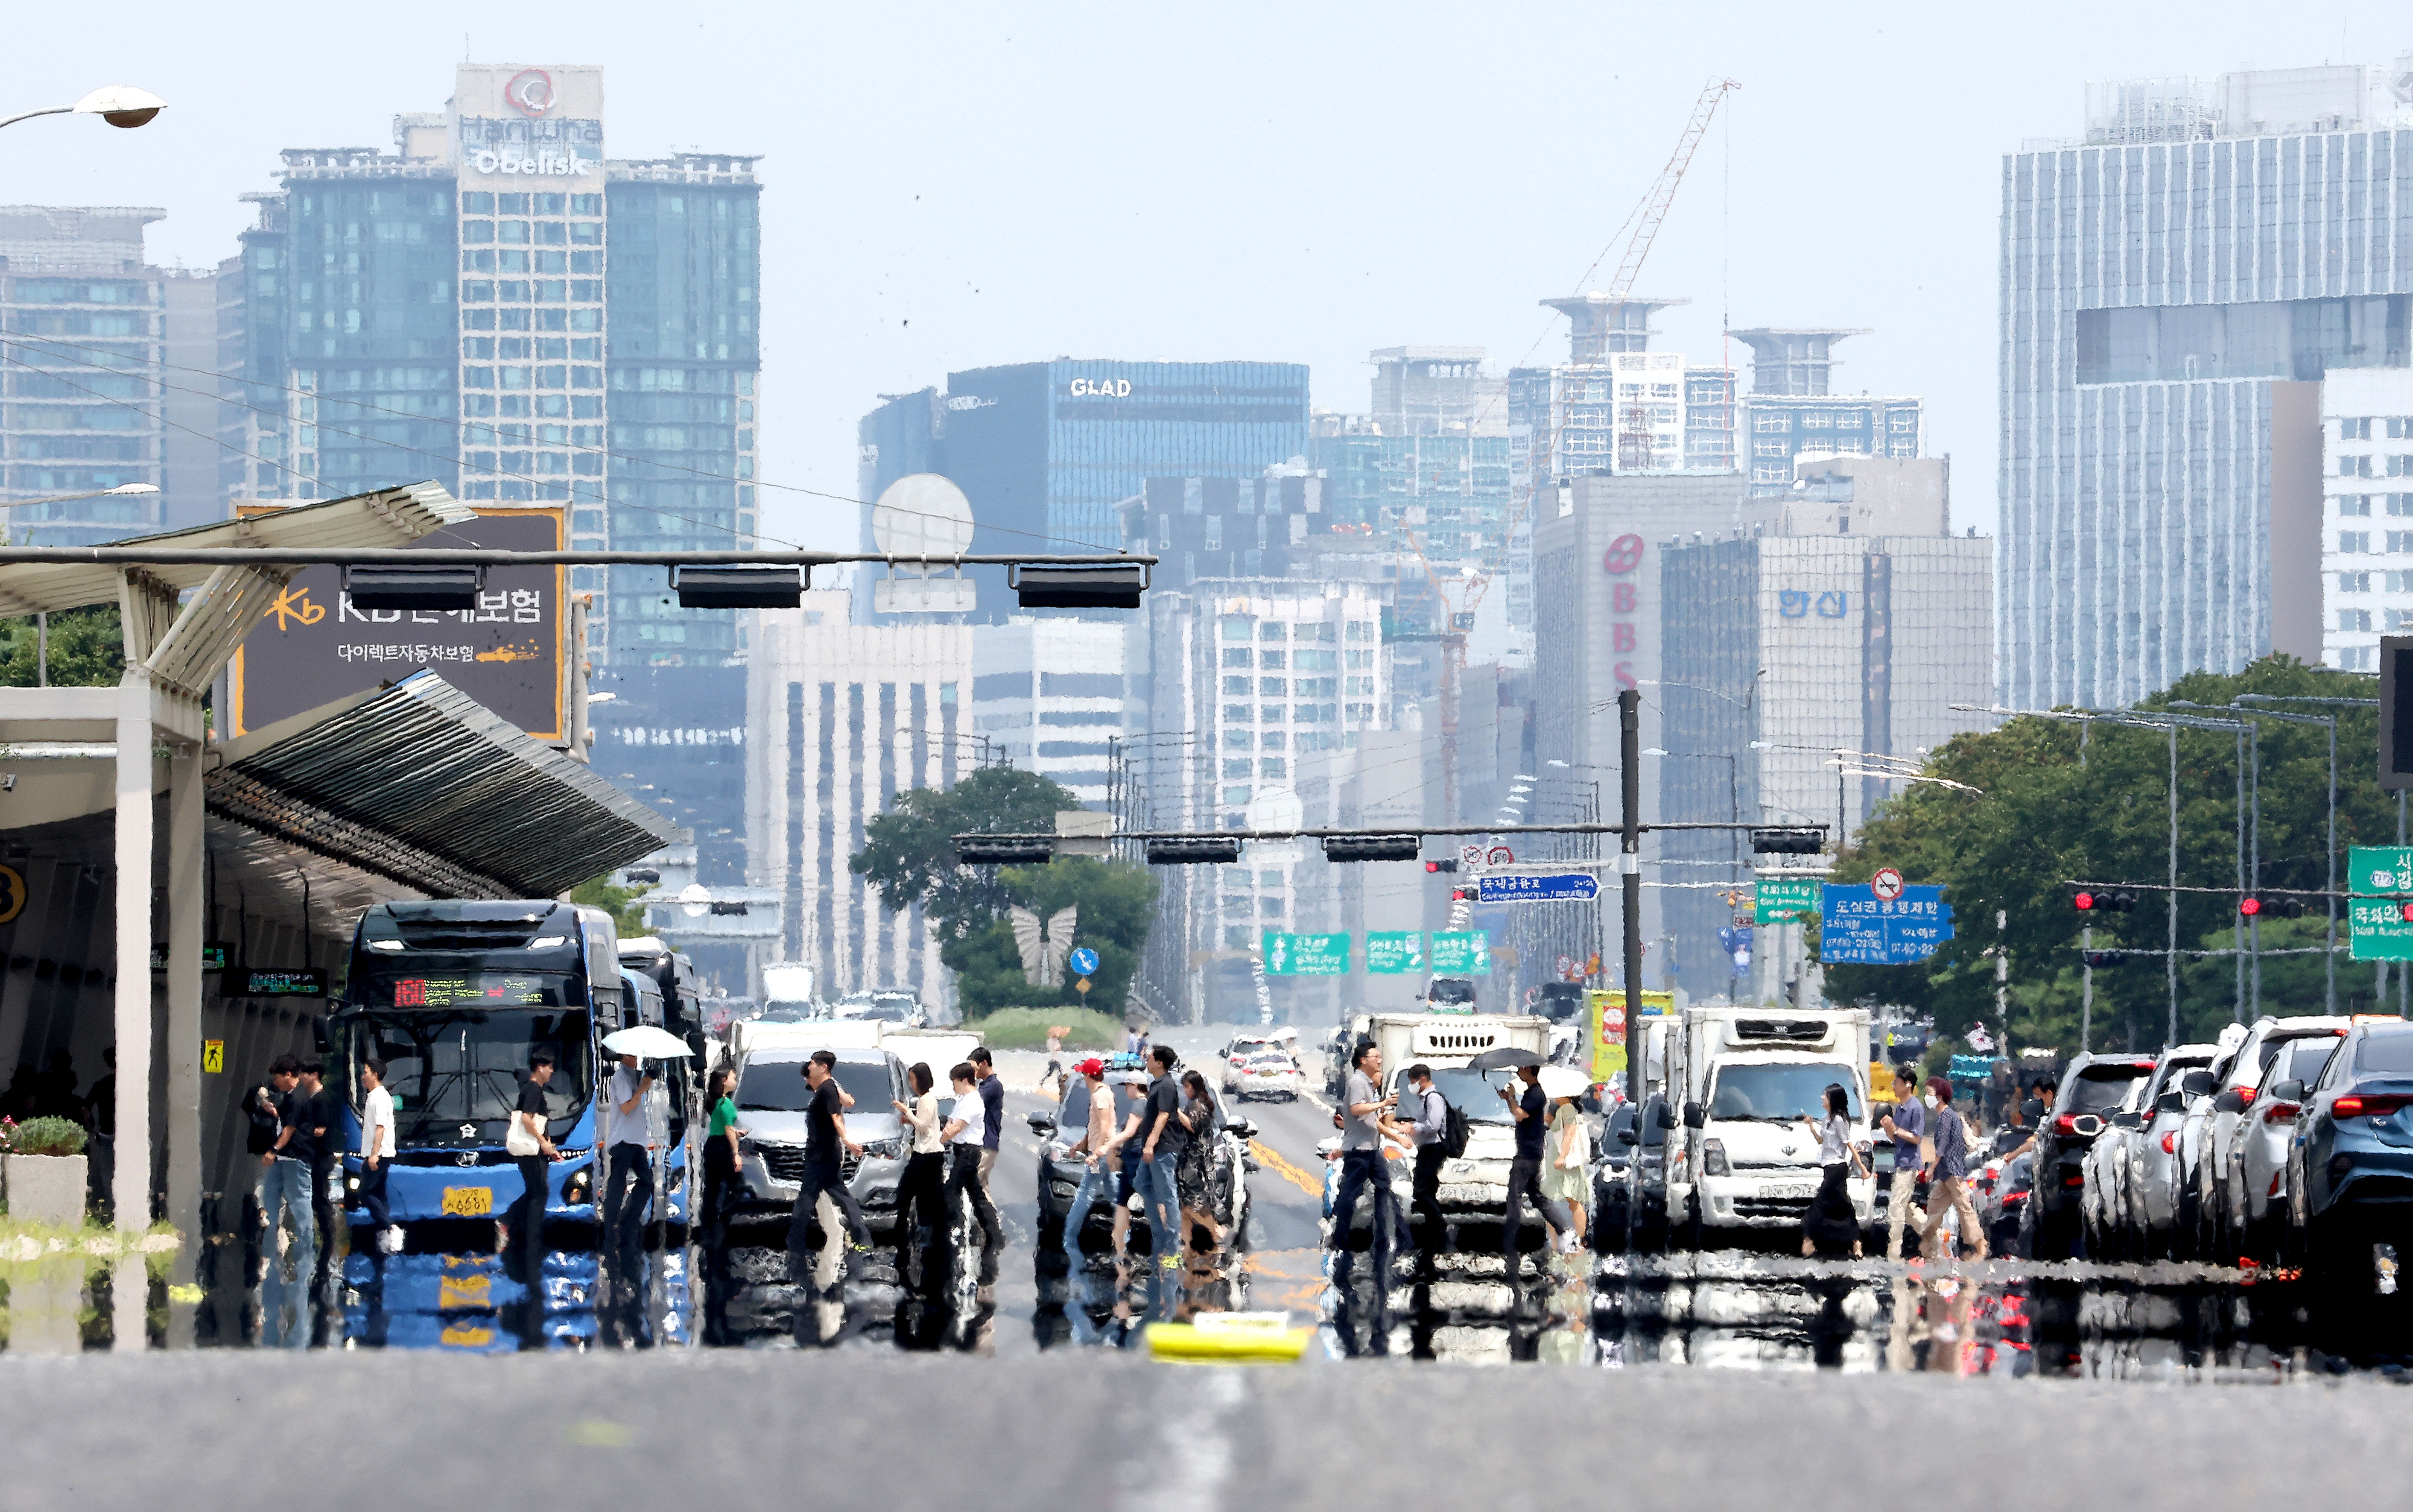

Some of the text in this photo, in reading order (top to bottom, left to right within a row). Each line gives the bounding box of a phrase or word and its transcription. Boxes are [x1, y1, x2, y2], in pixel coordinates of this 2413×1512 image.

[477, 149, 589, 176] Obelisk
[1070, 378, 1132, 397] GLAD
[1614, 583, 1636, 692] BBS
[337, 645, 474, 663] 다이렉트자동차보험
[1483, 878, 1541, 891] 국제금융로
[1836, 900, 1877, 913] 도심권
[395, 979, 425, 1007] 160
